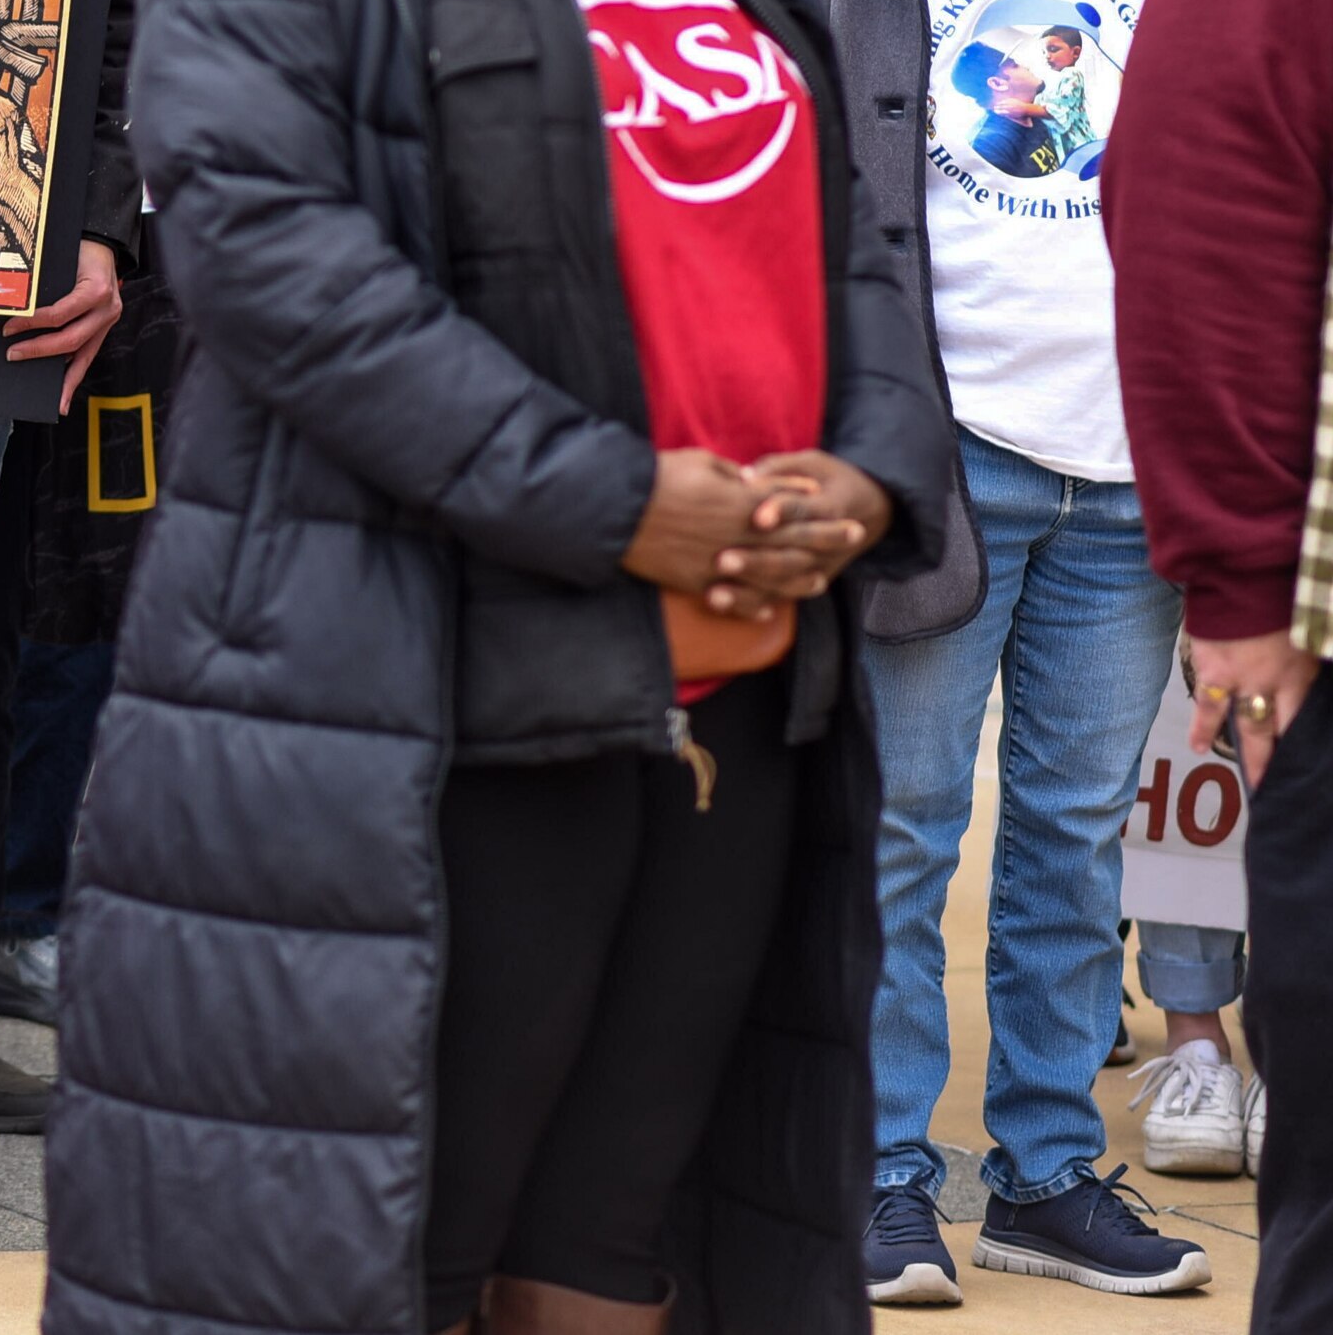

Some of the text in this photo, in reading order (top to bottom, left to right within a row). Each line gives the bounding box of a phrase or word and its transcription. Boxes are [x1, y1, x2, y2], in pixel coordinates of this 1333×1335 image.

[927, 144, 1102, 219] Home With his
